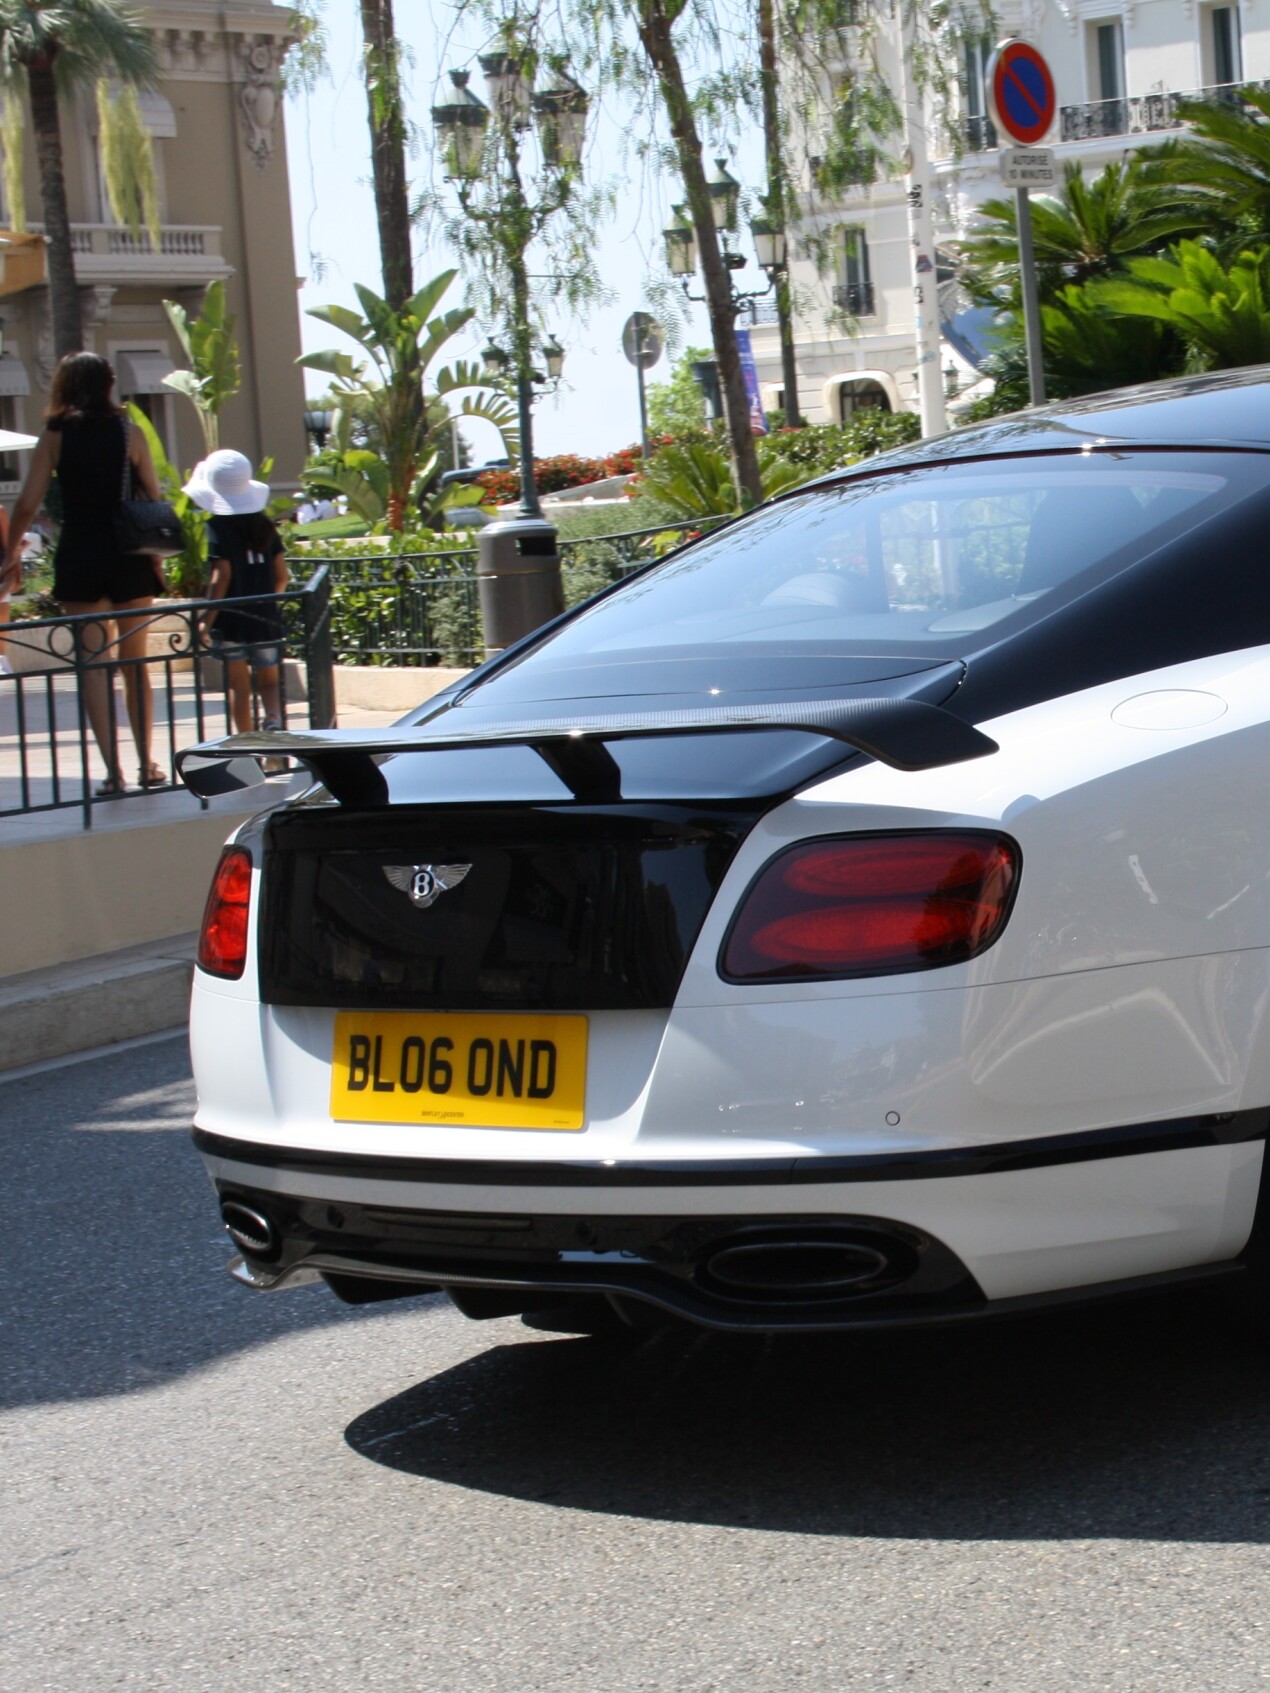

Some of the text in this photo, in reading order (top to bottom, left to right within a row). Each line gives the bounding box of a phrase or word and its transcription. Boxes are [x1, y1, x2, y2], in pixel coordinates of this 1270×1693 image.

[1008, 169, 1053, 180] 10 MINUTES
[414, 872, 430, 896] B
[347, 1034, 557, 1099] BL06 OND
